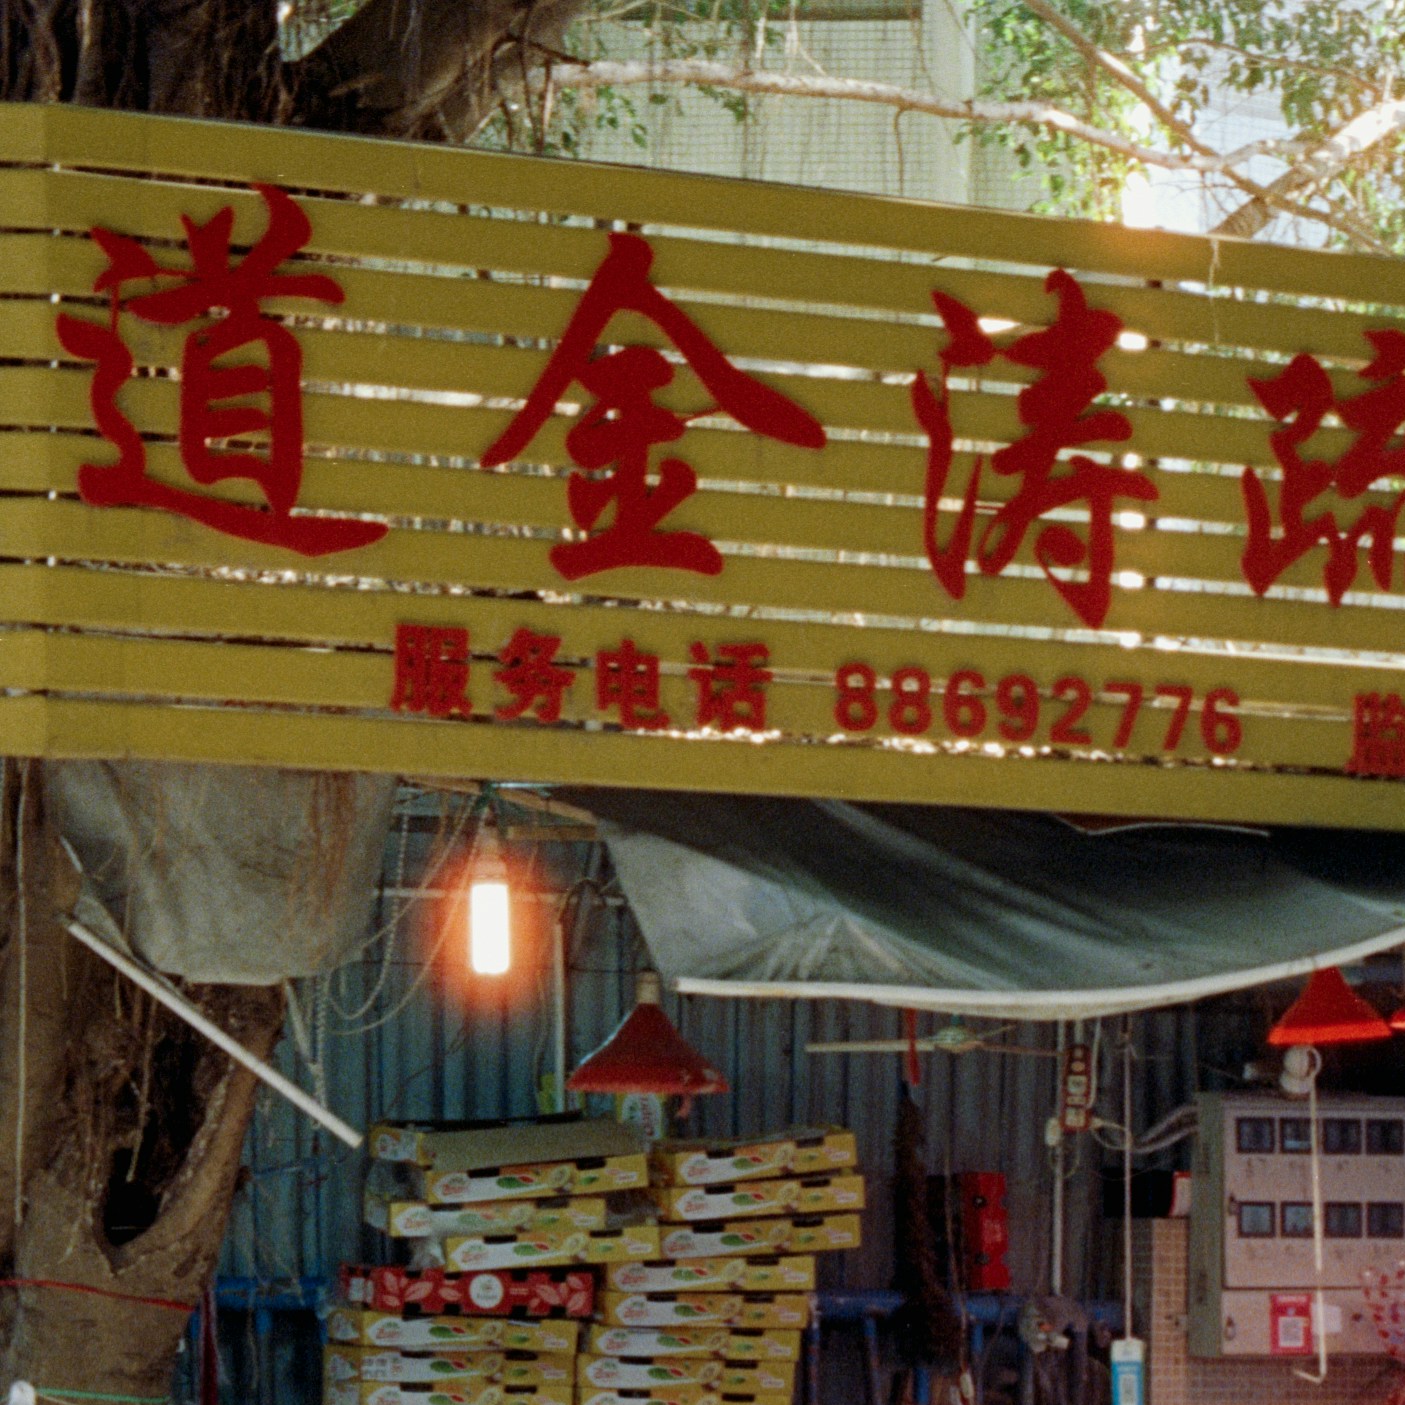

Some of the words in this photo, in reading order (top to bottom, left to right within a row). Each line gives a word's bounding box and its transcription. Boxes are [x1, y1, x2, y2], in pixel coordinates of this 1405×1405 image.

[389, 623, 773, 733] 服务电话
[833, 661, 1243, 756] 88692776
